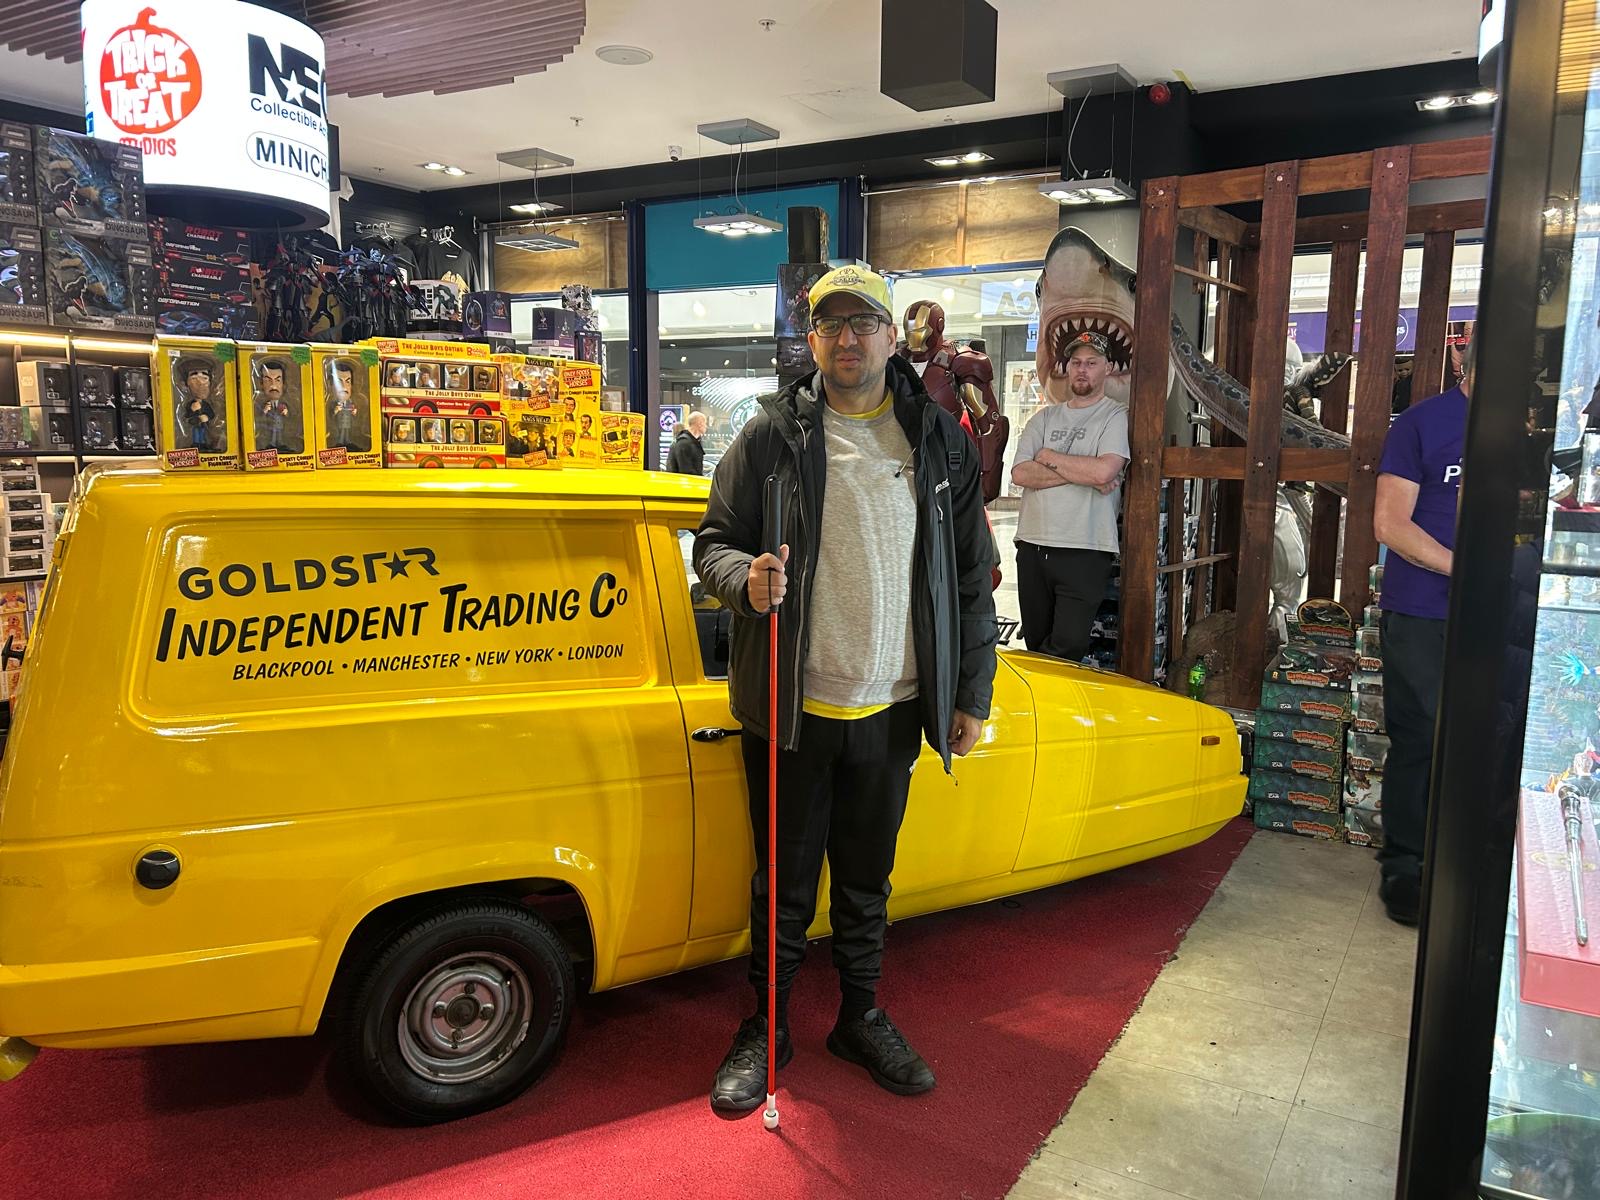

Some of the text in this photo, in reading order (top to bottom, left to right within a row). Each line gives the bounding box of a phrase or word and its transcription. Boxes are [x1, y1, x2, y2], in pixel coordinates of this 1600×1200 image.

[104, 29, 191, 78] TRICK
[104, 80, 191, 129] TREAT
[250, 97, 317, 130] Collectible
[105, 222, 147, 236] DINOSAUR
[114, 318, 155, 329] DINOSAUR
[155, 601, 429, 662] INDEPENDENT
[439, 583, 580, 633] TRADING
[232, 643, 624, 681] BLACKPOOL MANCHESTER NEW YORK LONDON
